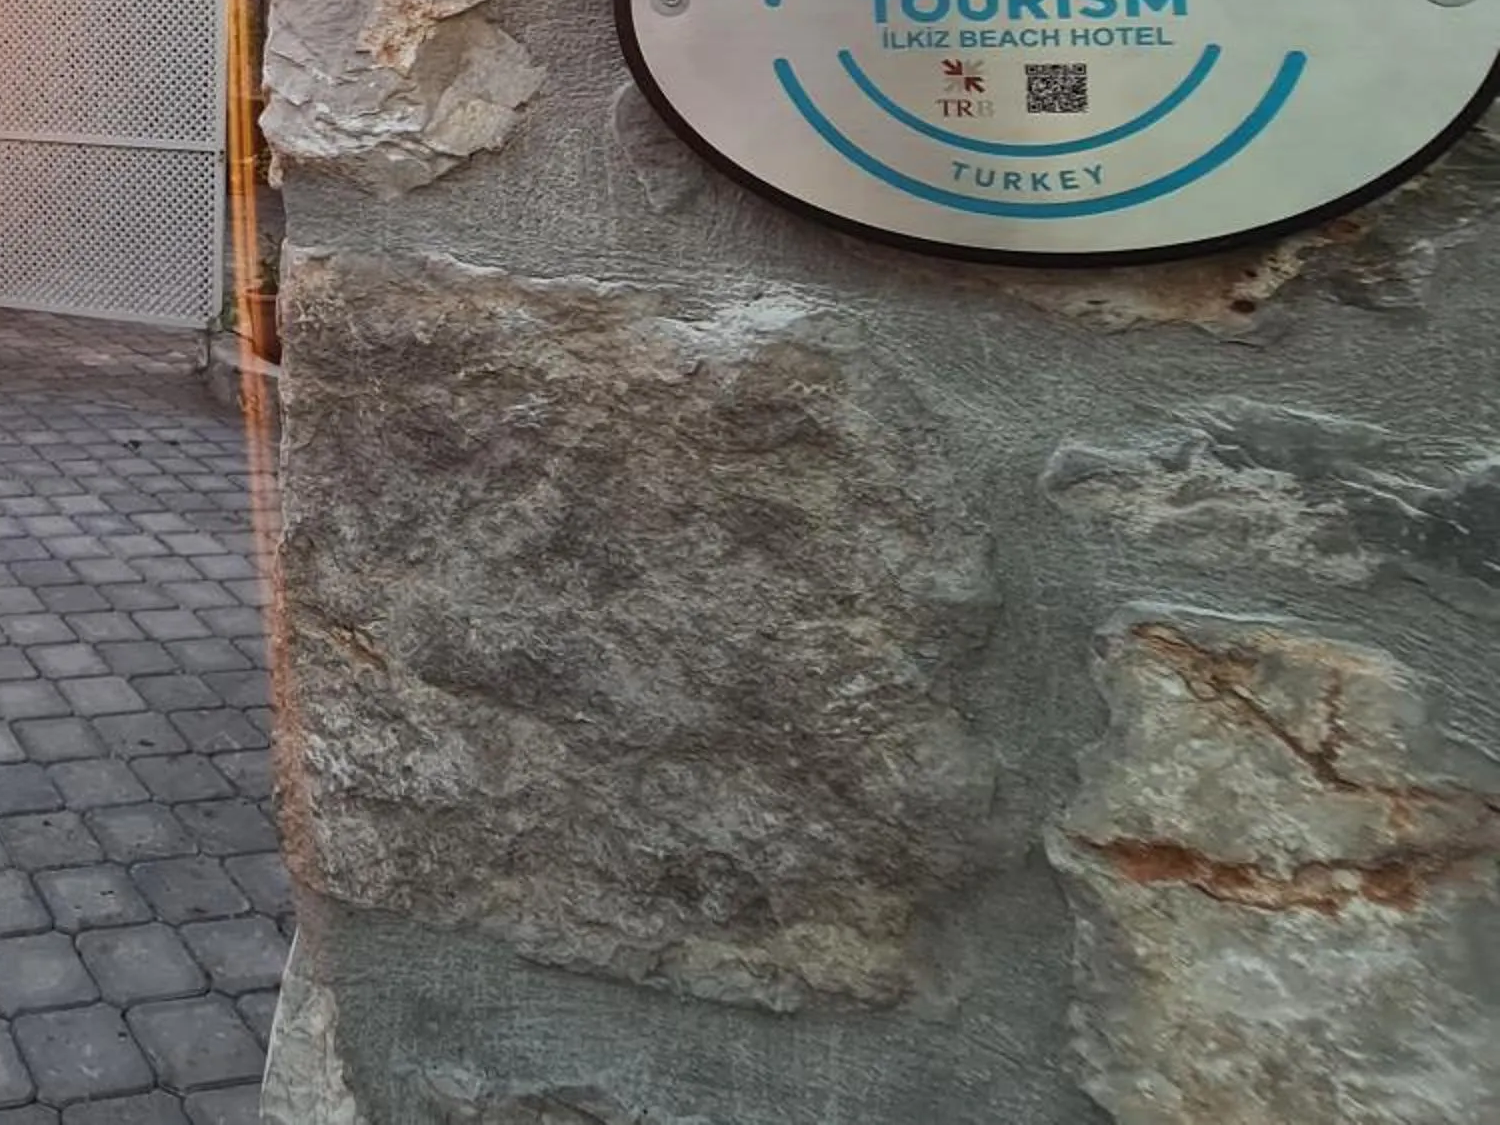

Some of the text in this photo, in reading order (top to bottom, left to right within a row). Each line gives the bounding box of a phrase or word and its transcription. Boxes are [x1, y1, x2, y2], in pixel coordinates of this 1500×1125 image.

[882, 27, 1173, 49] İLKİZ BEACH HOTEL
[951, 161, 1105, 192] TURKEY
